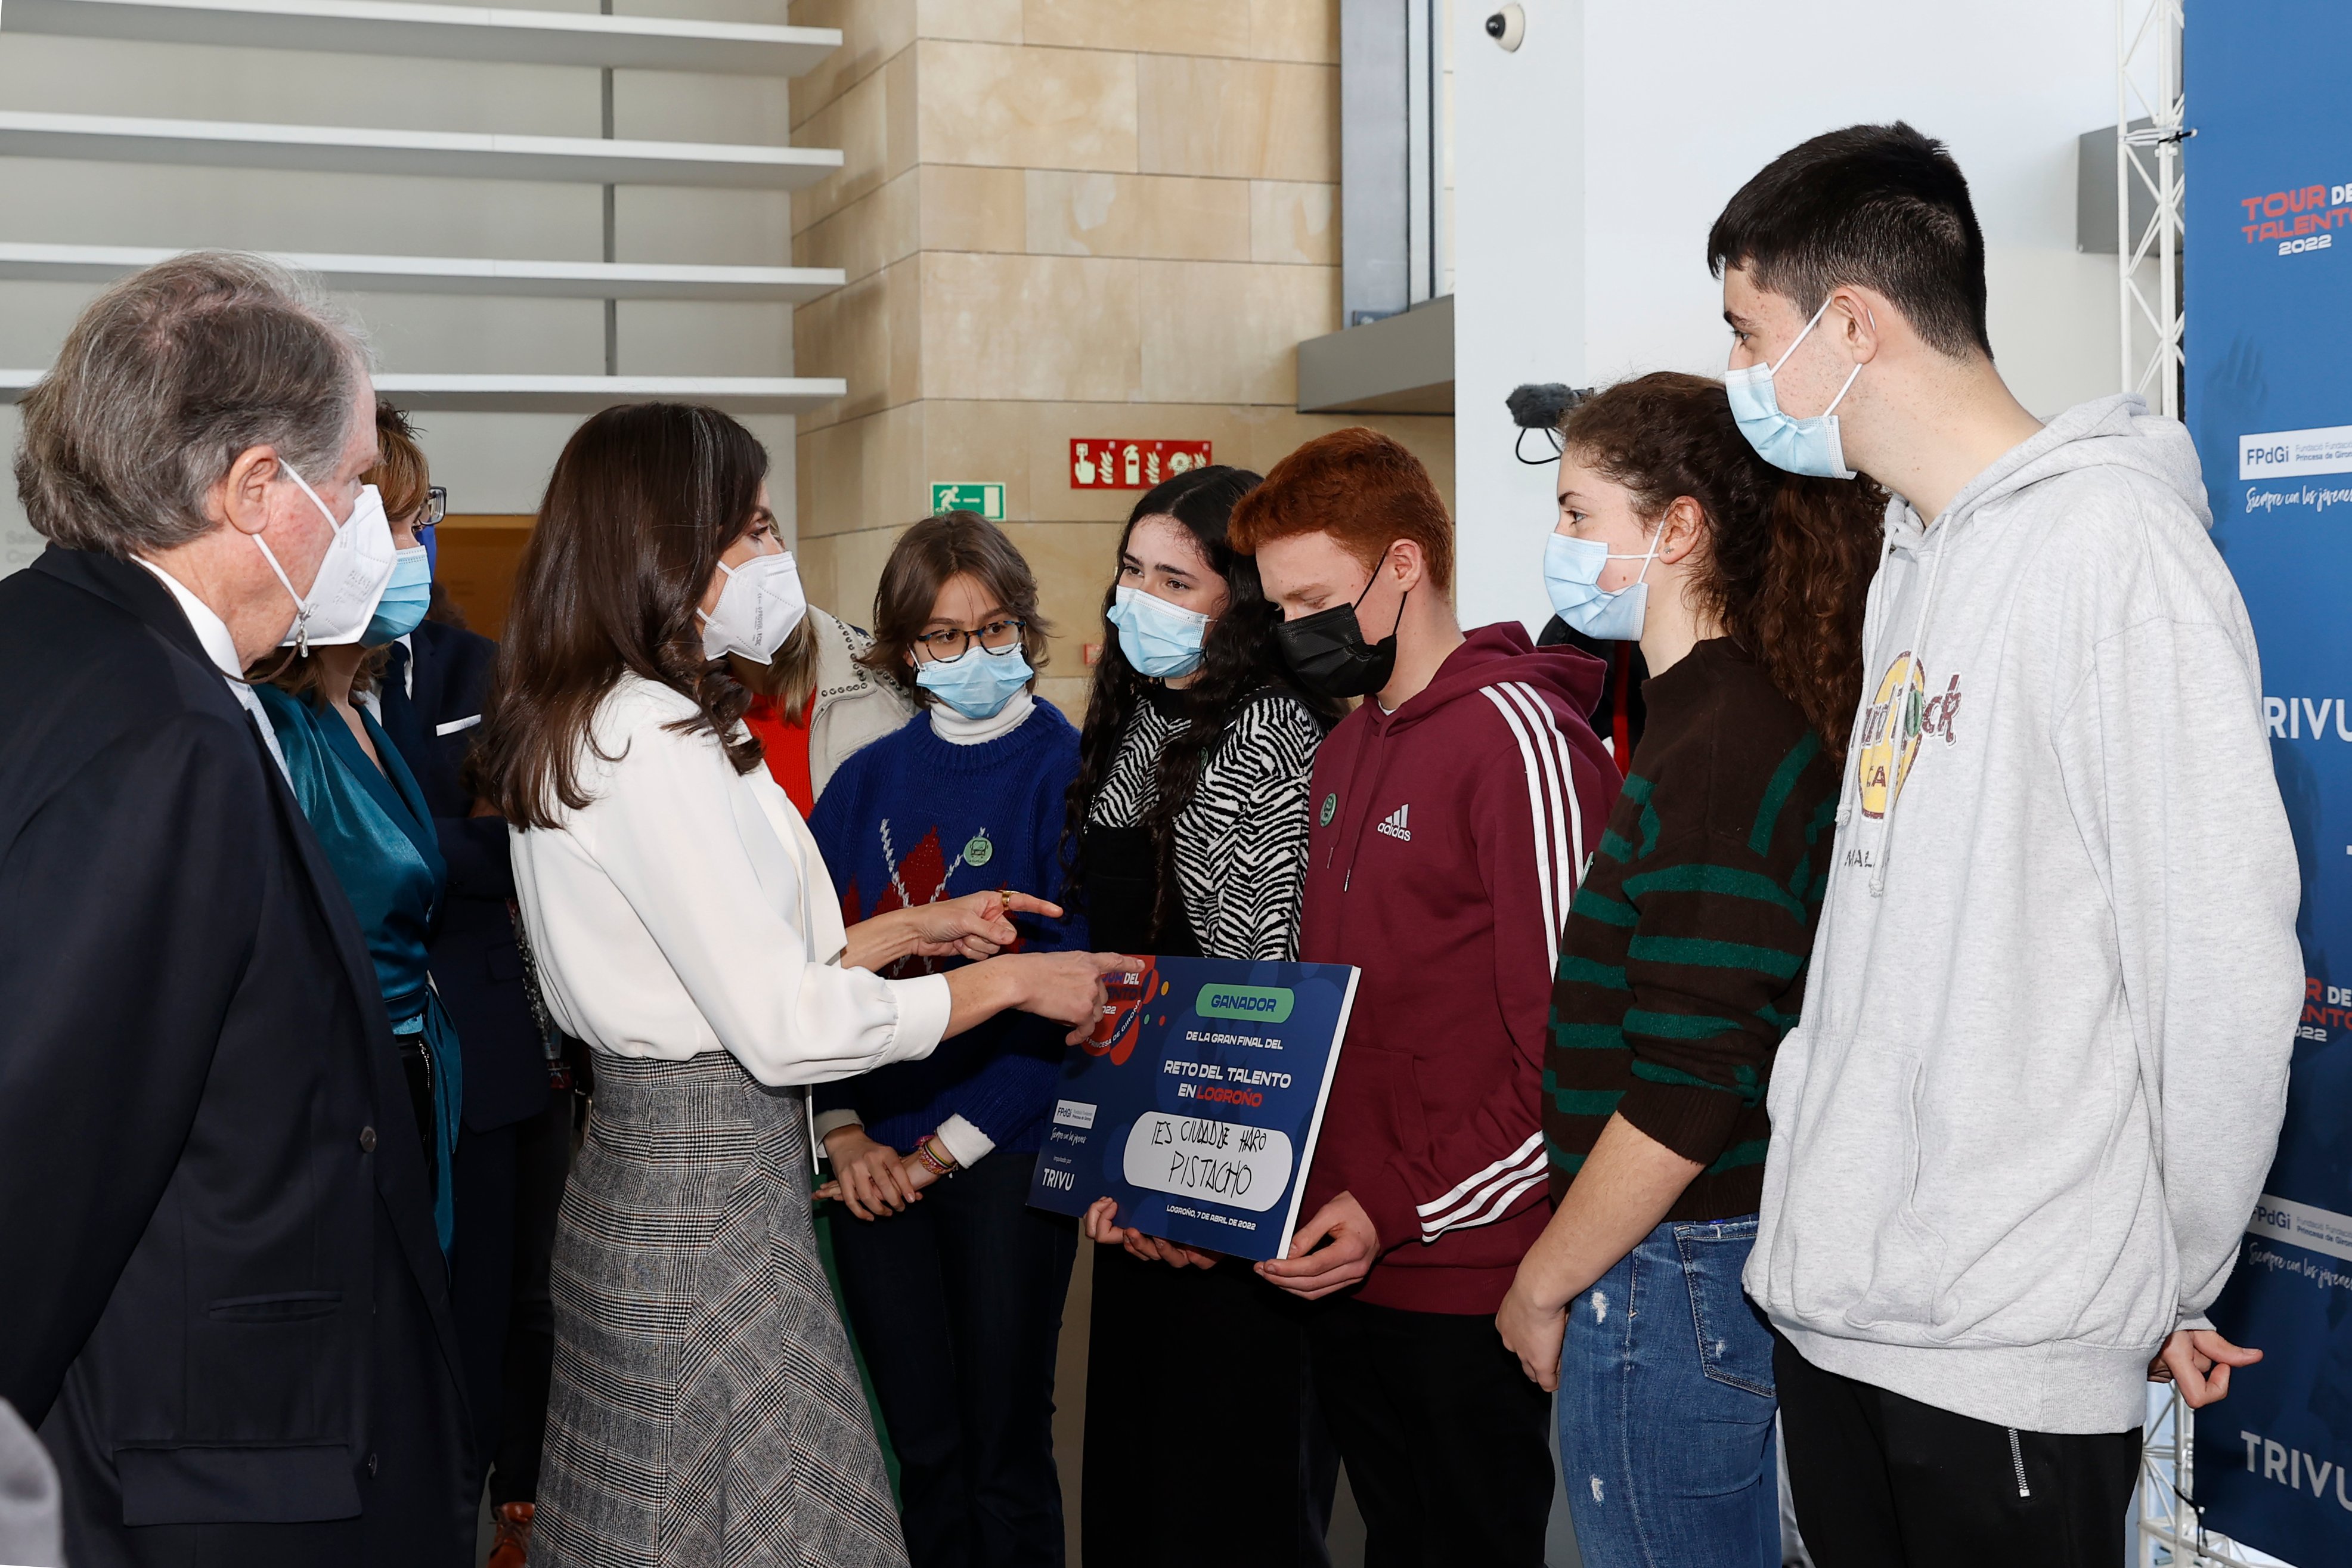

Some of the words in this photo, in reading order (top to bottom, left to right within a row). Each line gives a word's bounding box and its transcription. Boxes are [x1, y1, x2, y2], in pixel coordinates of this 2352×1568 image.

[2241, 184, 2326, 221] TOUR
[2242, 207, 2352, 244] TALENT
[2278, 234, 2332, 256] 2022
[2246, 446, 2289, 465] FPdGi
[2263, 696, 2352, 742] RIVU
[1377, 822, 1411, 842] adidas
[1123, 972, 1139, 985] DEL
[1102, 1005, 1117, 1015] 022
[1211, 994, 1277, 1012] GANADOR
[1113, 1030, 1120, 1041] DE
[1121, 1000, 1141, 1033] GIRONA
[1186, 1031, 1198, 1041] DE
[1198, 1032, 1210, 1042] LA
[1211, 1033, 1237, 1045] GRAN
[1237, 1036, 1263, 1048] FINAL
[1265, 1039, 1283, 1050] DEL
[2295, 1025, 2327, 1042] 022
[1163, 1060, 1198, 1077] RETO
[1198, 1064, 1223, 1080] DEL
[1227, 1067, 1291, 1089] TALENTO
[1177, 1083, 1197, 1098] EN
[1197, 1085, 1263, 1107] LOGROÑO
[1057, 1107, 1073, 1118] FPdGi
[1151, 1121, 1172, 1145] IES
[1238, 1127, 1266, 1152] HARO
[1042, 1168, 1074, 1191] TRIVU
[1169, 1150, 1252, 1198] PISTACHO
[1166, 1205, 1196, 1218] LOGROÑO,
[1210, 1214, 1228, 1224] ABRIL
[1228, 1218, 1238, 1226] DE
[1238, 1220, 1256, 1231] 2022
[2335, 1236, 2352, 1247] Giron
[2241, 1430, 2352, 1512] TRIVU
